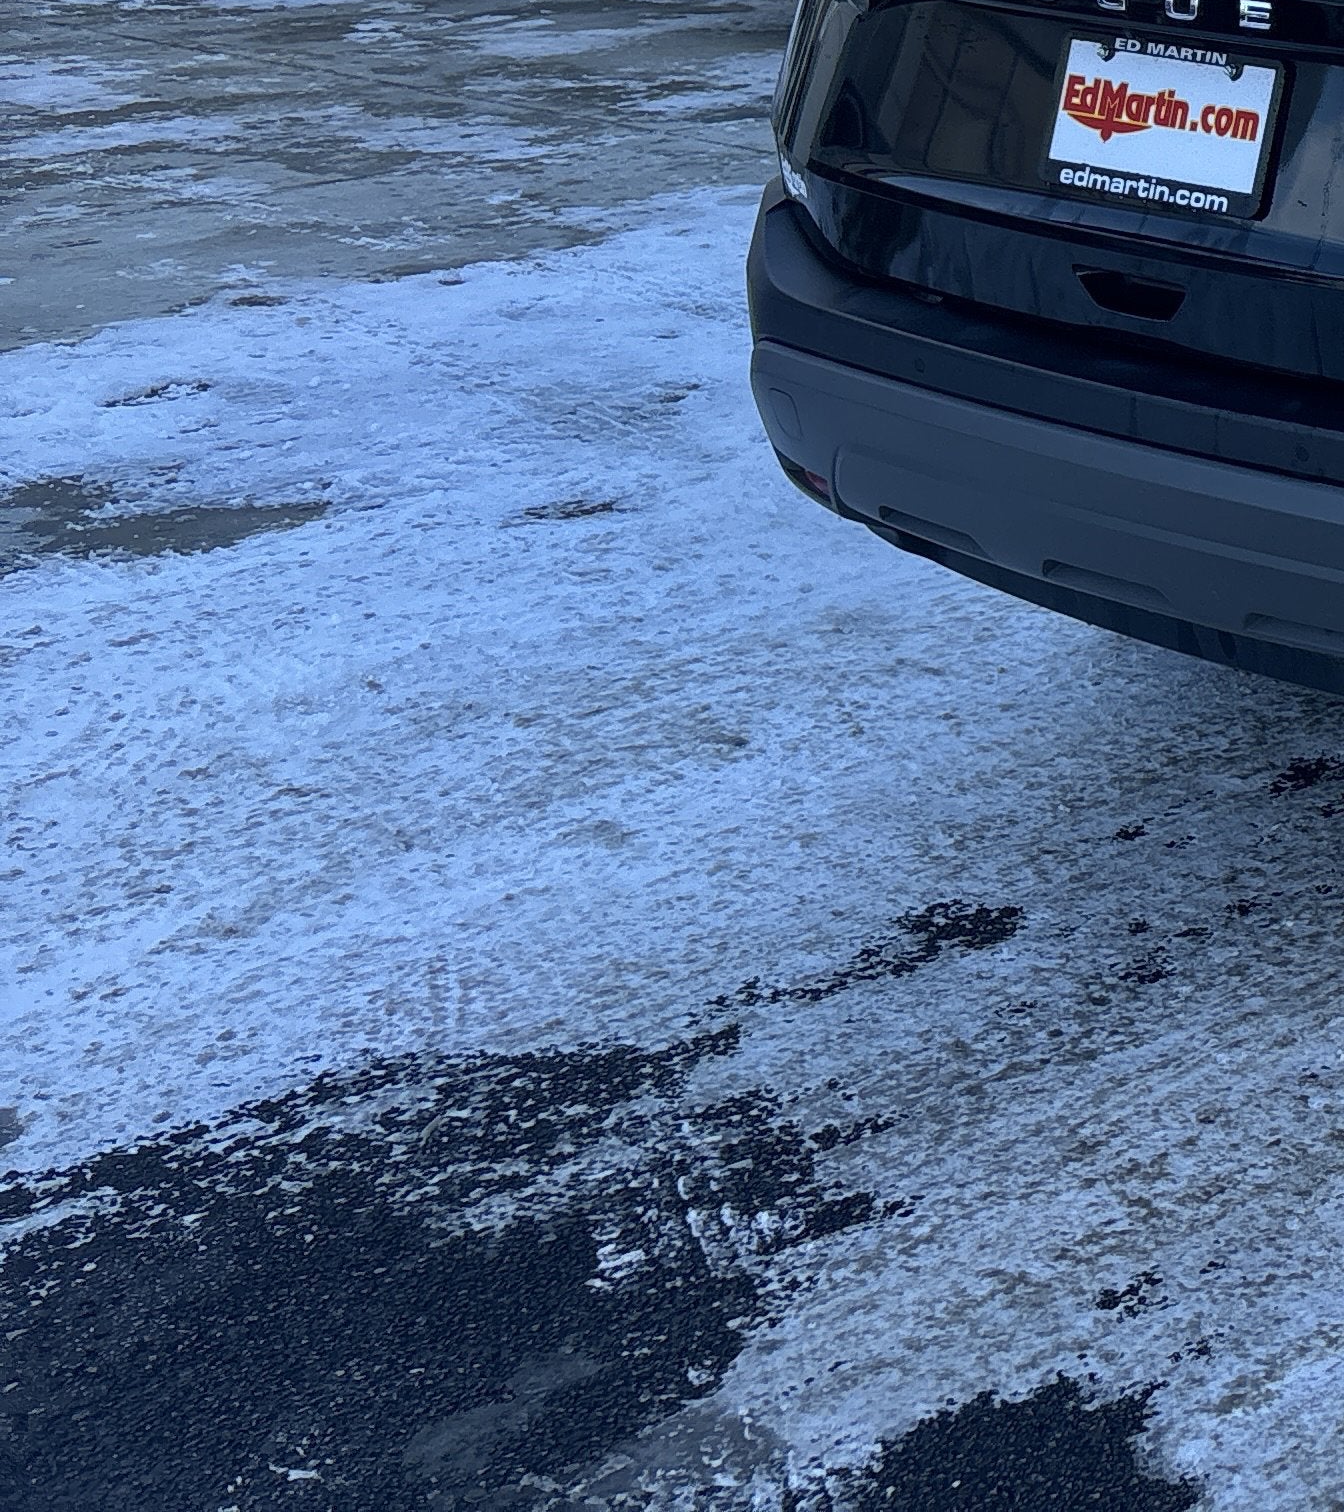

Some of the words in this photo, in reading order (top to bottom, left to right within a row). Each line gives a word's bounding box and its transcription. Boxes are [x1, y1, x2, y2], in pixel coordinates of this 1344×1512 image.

[1114, 37, 1141, 52] ED
[1146, 42, 1228, 66] MARTIN
[1063, 73, 1260, 142] EdMartin.com
[1059, 167, 1229, 214] edmartin.com
